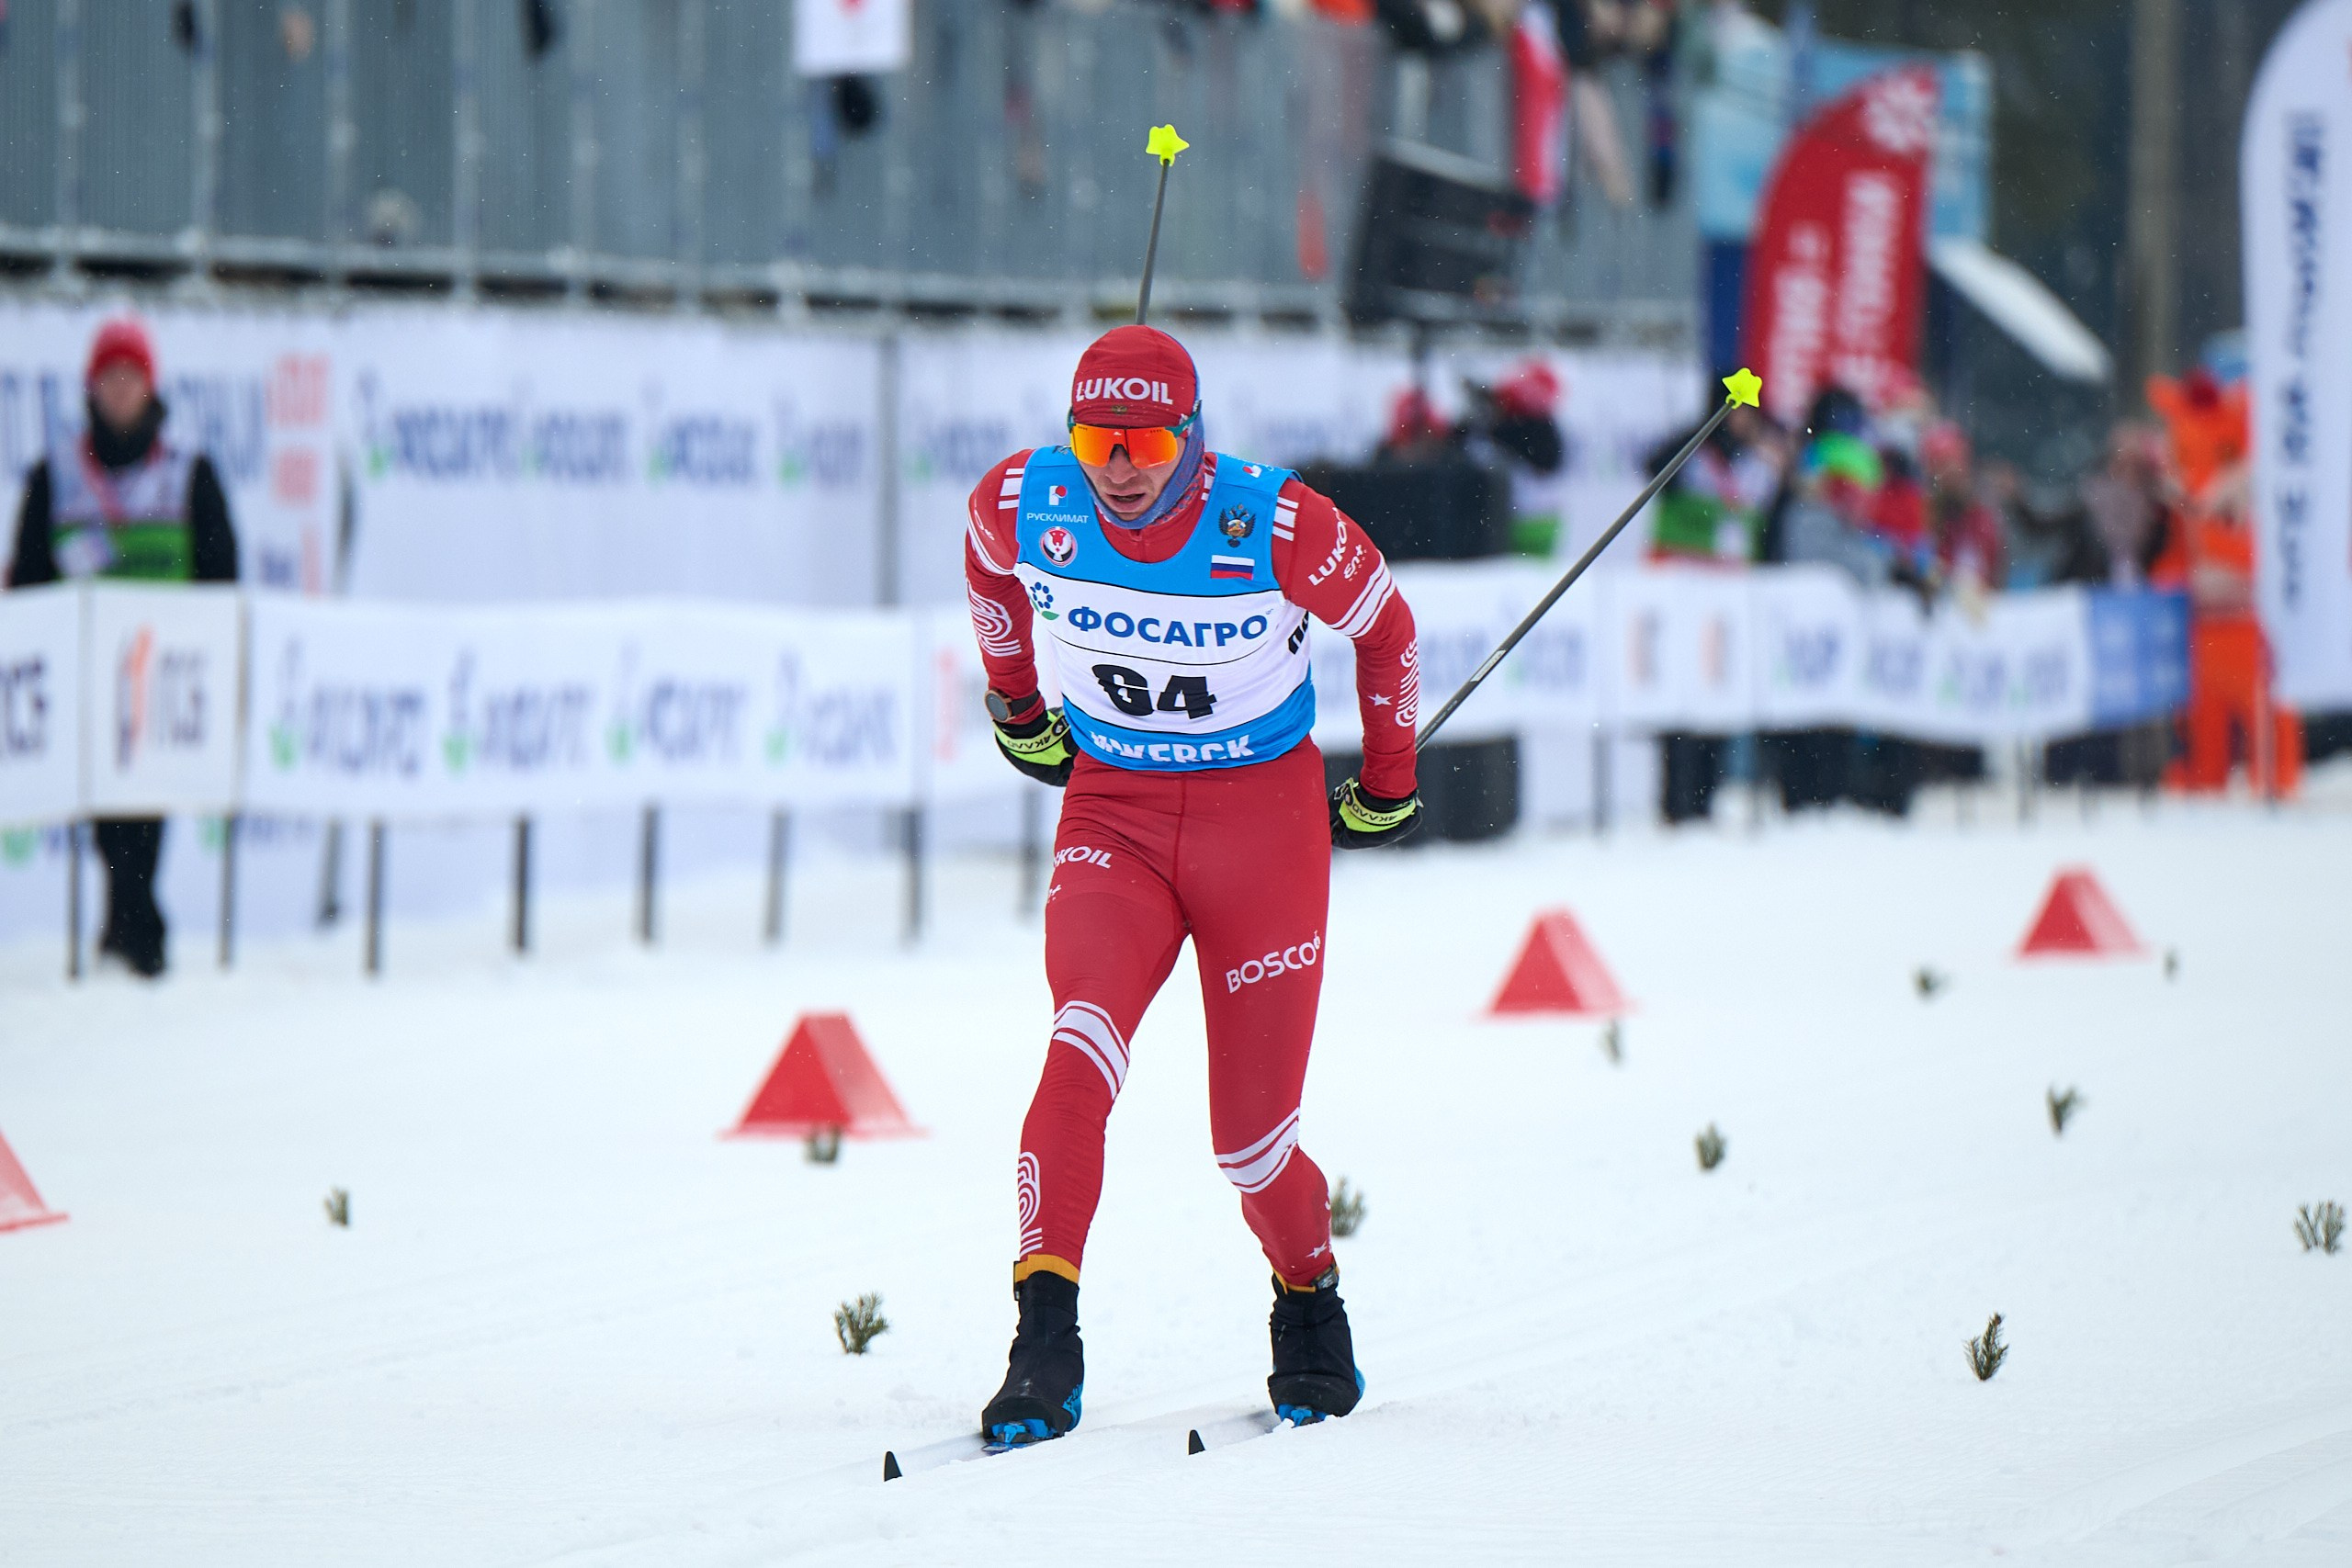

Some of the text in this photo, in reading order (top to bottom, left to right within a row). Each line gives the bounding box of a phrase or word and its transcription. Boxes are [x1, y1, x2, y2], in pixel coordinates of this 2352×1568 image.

[1076, 378, 1173, 405] LUKOIL
[1026, 513, 1089, 524] РУСКЛИМАТ
[1068, 606, 1268, 647] ФОСАГРО
[1091, 664, 1217, 720] 64
[1226, 942, 1317, 993] BOSCO
